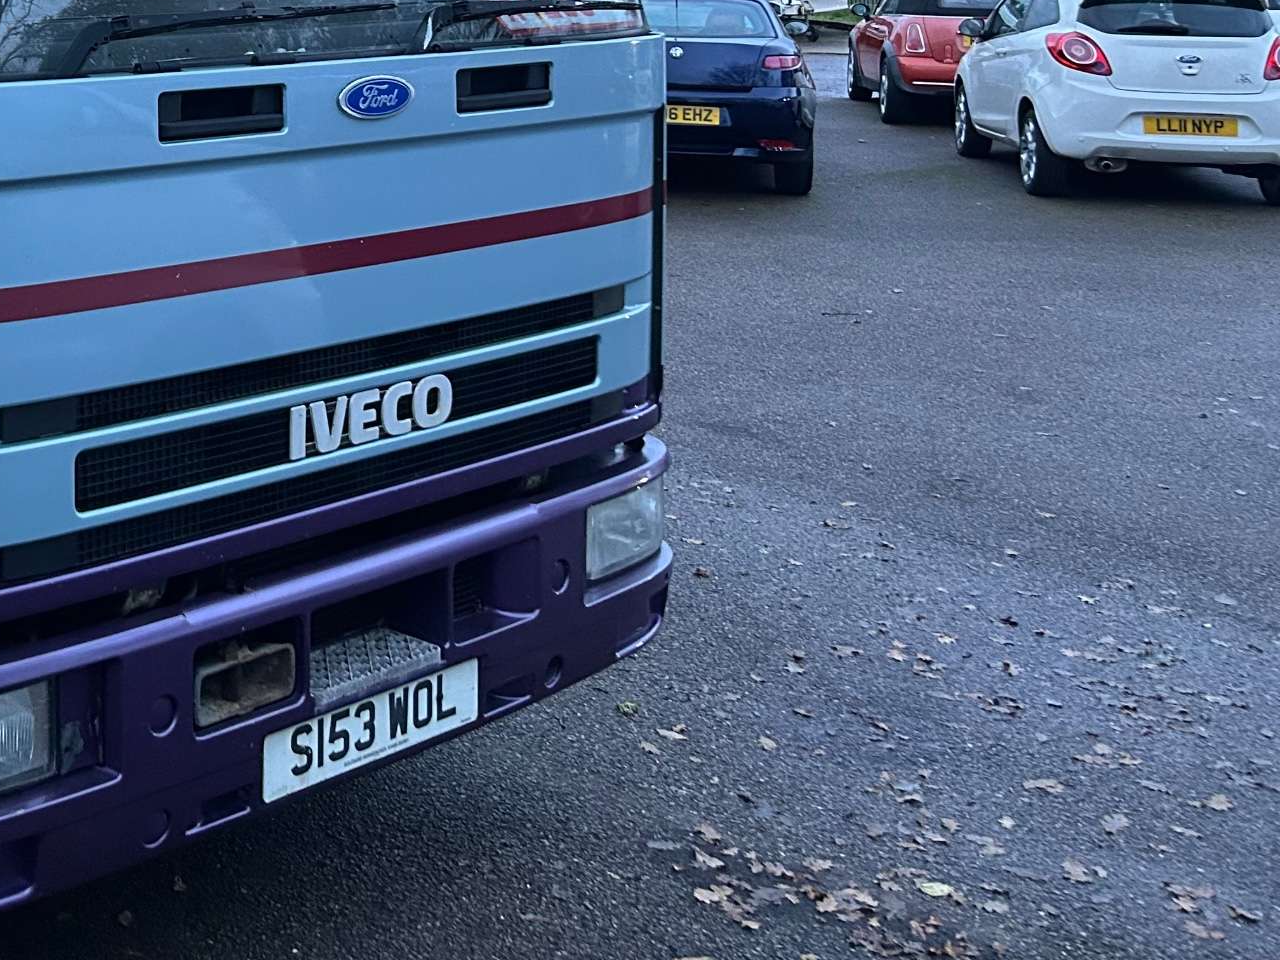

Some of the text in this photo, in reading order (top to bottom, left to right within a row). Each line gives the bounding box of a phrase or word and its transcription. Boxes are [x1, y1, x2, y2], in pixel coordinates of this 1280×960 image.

[358, 84, 399, 109] Ford
[666, 107, 713, 122] 6 EHZ
[1156, 118, 1225, 134] LL11 NYP
[288, 373, 453, 461] IVECO
[290, 674, 457, 777] S153 WOL
